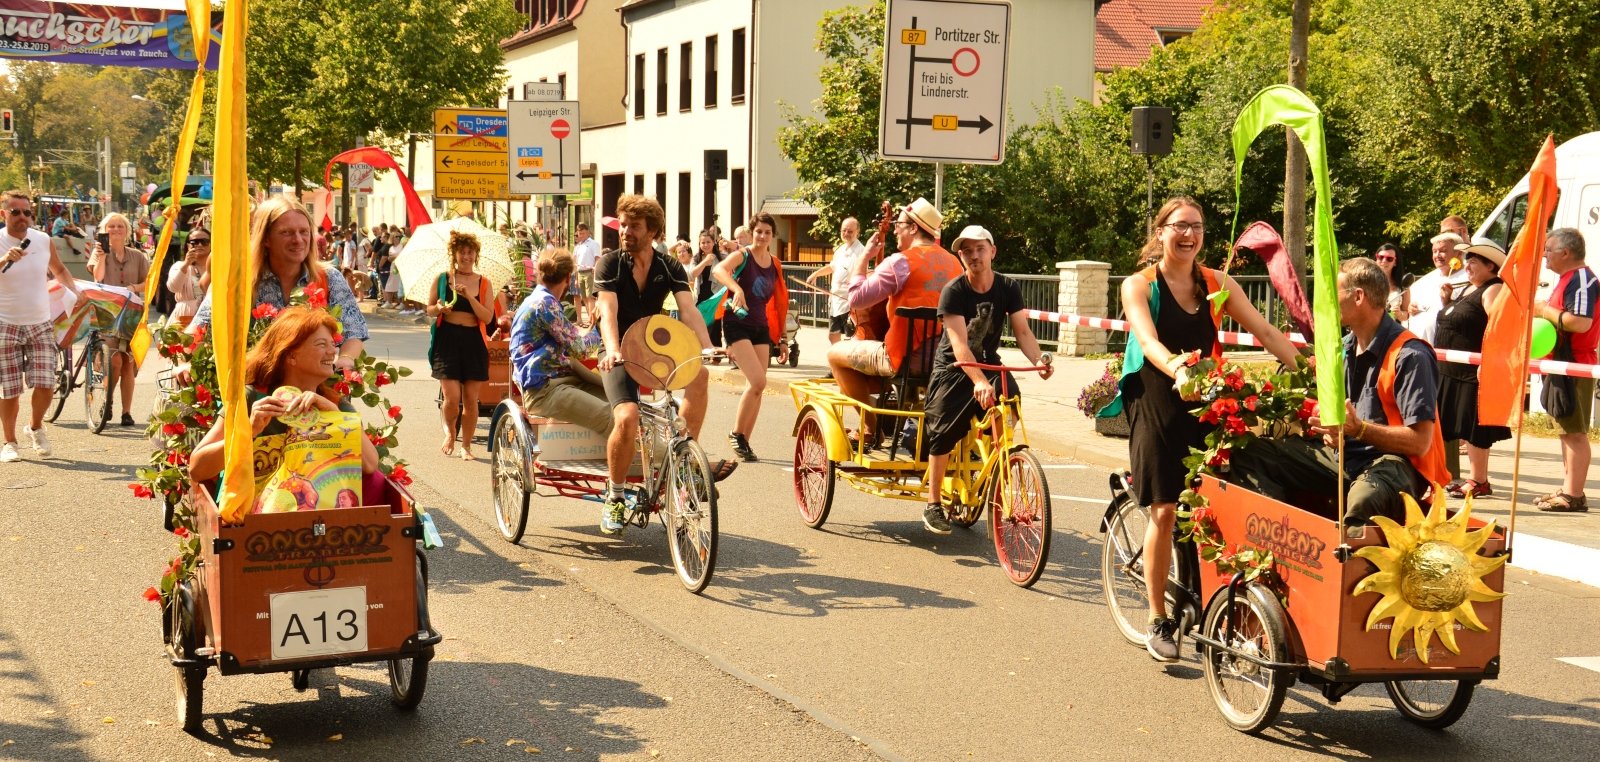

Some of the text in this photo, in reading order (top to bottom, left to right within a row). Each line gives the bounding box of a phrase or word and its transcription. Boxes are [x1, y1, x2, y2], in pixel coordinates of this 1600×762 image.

[908, 32, 920, 42] 87
[935, 27, 1000, 44] Portitzer Str.
[61, 45, 168, 58] Das Stadtfest von Taucha
[922, 72, 954, 84] frei bis
[921, 86, 969, 99] Lindnerstr.
[529, 108, 559, 118] Leipziger
[475, 117, 507, 126] Dresden
[941, 118, 949, 127] U
[456, 158, 498, 168] Engelsdorf
[449, 177, 475, 186] Torgau
[441, 186, 476, 196] Eilenburg
[479, 187, 487, 195] 15
[1246, 512, 1327, 563] ANCIENT
[369, 602, 384, 610] von
[256, 612, 270, 620] Mit
[280, 609, 359, 647] A13
